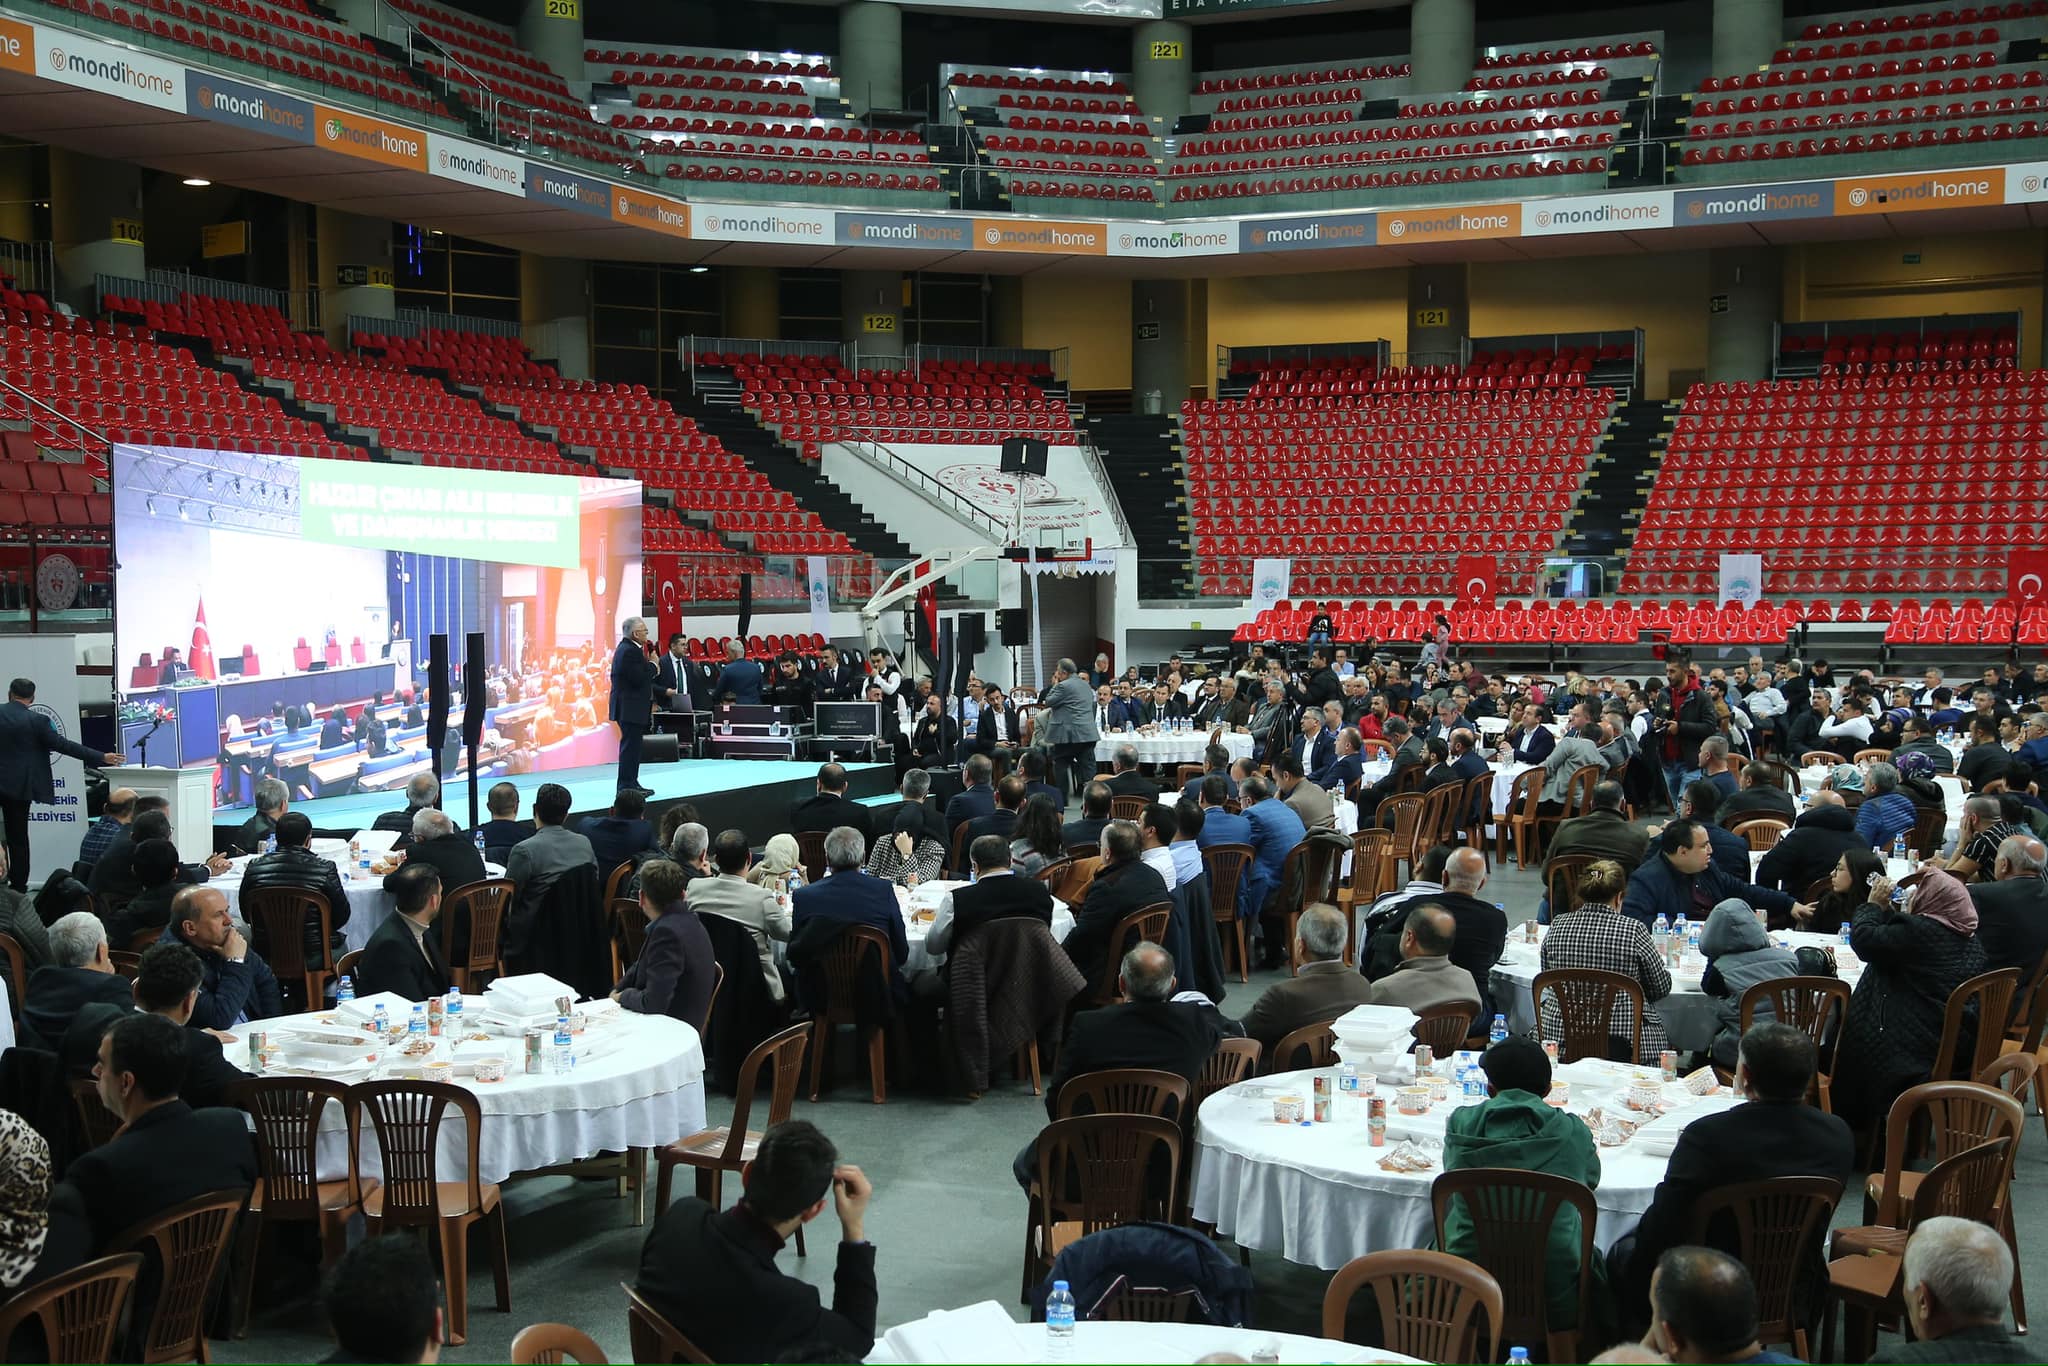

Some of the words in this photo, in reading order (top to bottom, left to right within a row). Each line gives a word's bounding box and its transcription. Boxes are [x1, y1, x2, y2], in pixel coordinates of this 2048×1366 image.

[548, 1, 575, 17] 201
[1153, 44, 1179, 57] 221
[69, 55, 173, 96] mondihome
[214, 92, 305, 130] mondihome
[449, 153, 517, 184] mondihome
[544, 179, 606, 208] mondihome
[1869, 180, 1990, 203] mondihome
[1706, 192, 1821, 216] mondihome
[628, 202, 684, 227] mondihome
[1406, 214, 1509, 233] mondihome
[1553, 204, 1660, 225] mondihome
[722, 217, 823, 235] mondihome
[865, 223, 962, 241] mondihome
[1267, 223, 1365, 242] mondihome
[1001, 228, 1096, 247] mondihome
[866, 317, 893, 329] 122
[1418, 311, 1443, 325] 121
[27, 811, 76, 822] ELEDİYESİ
